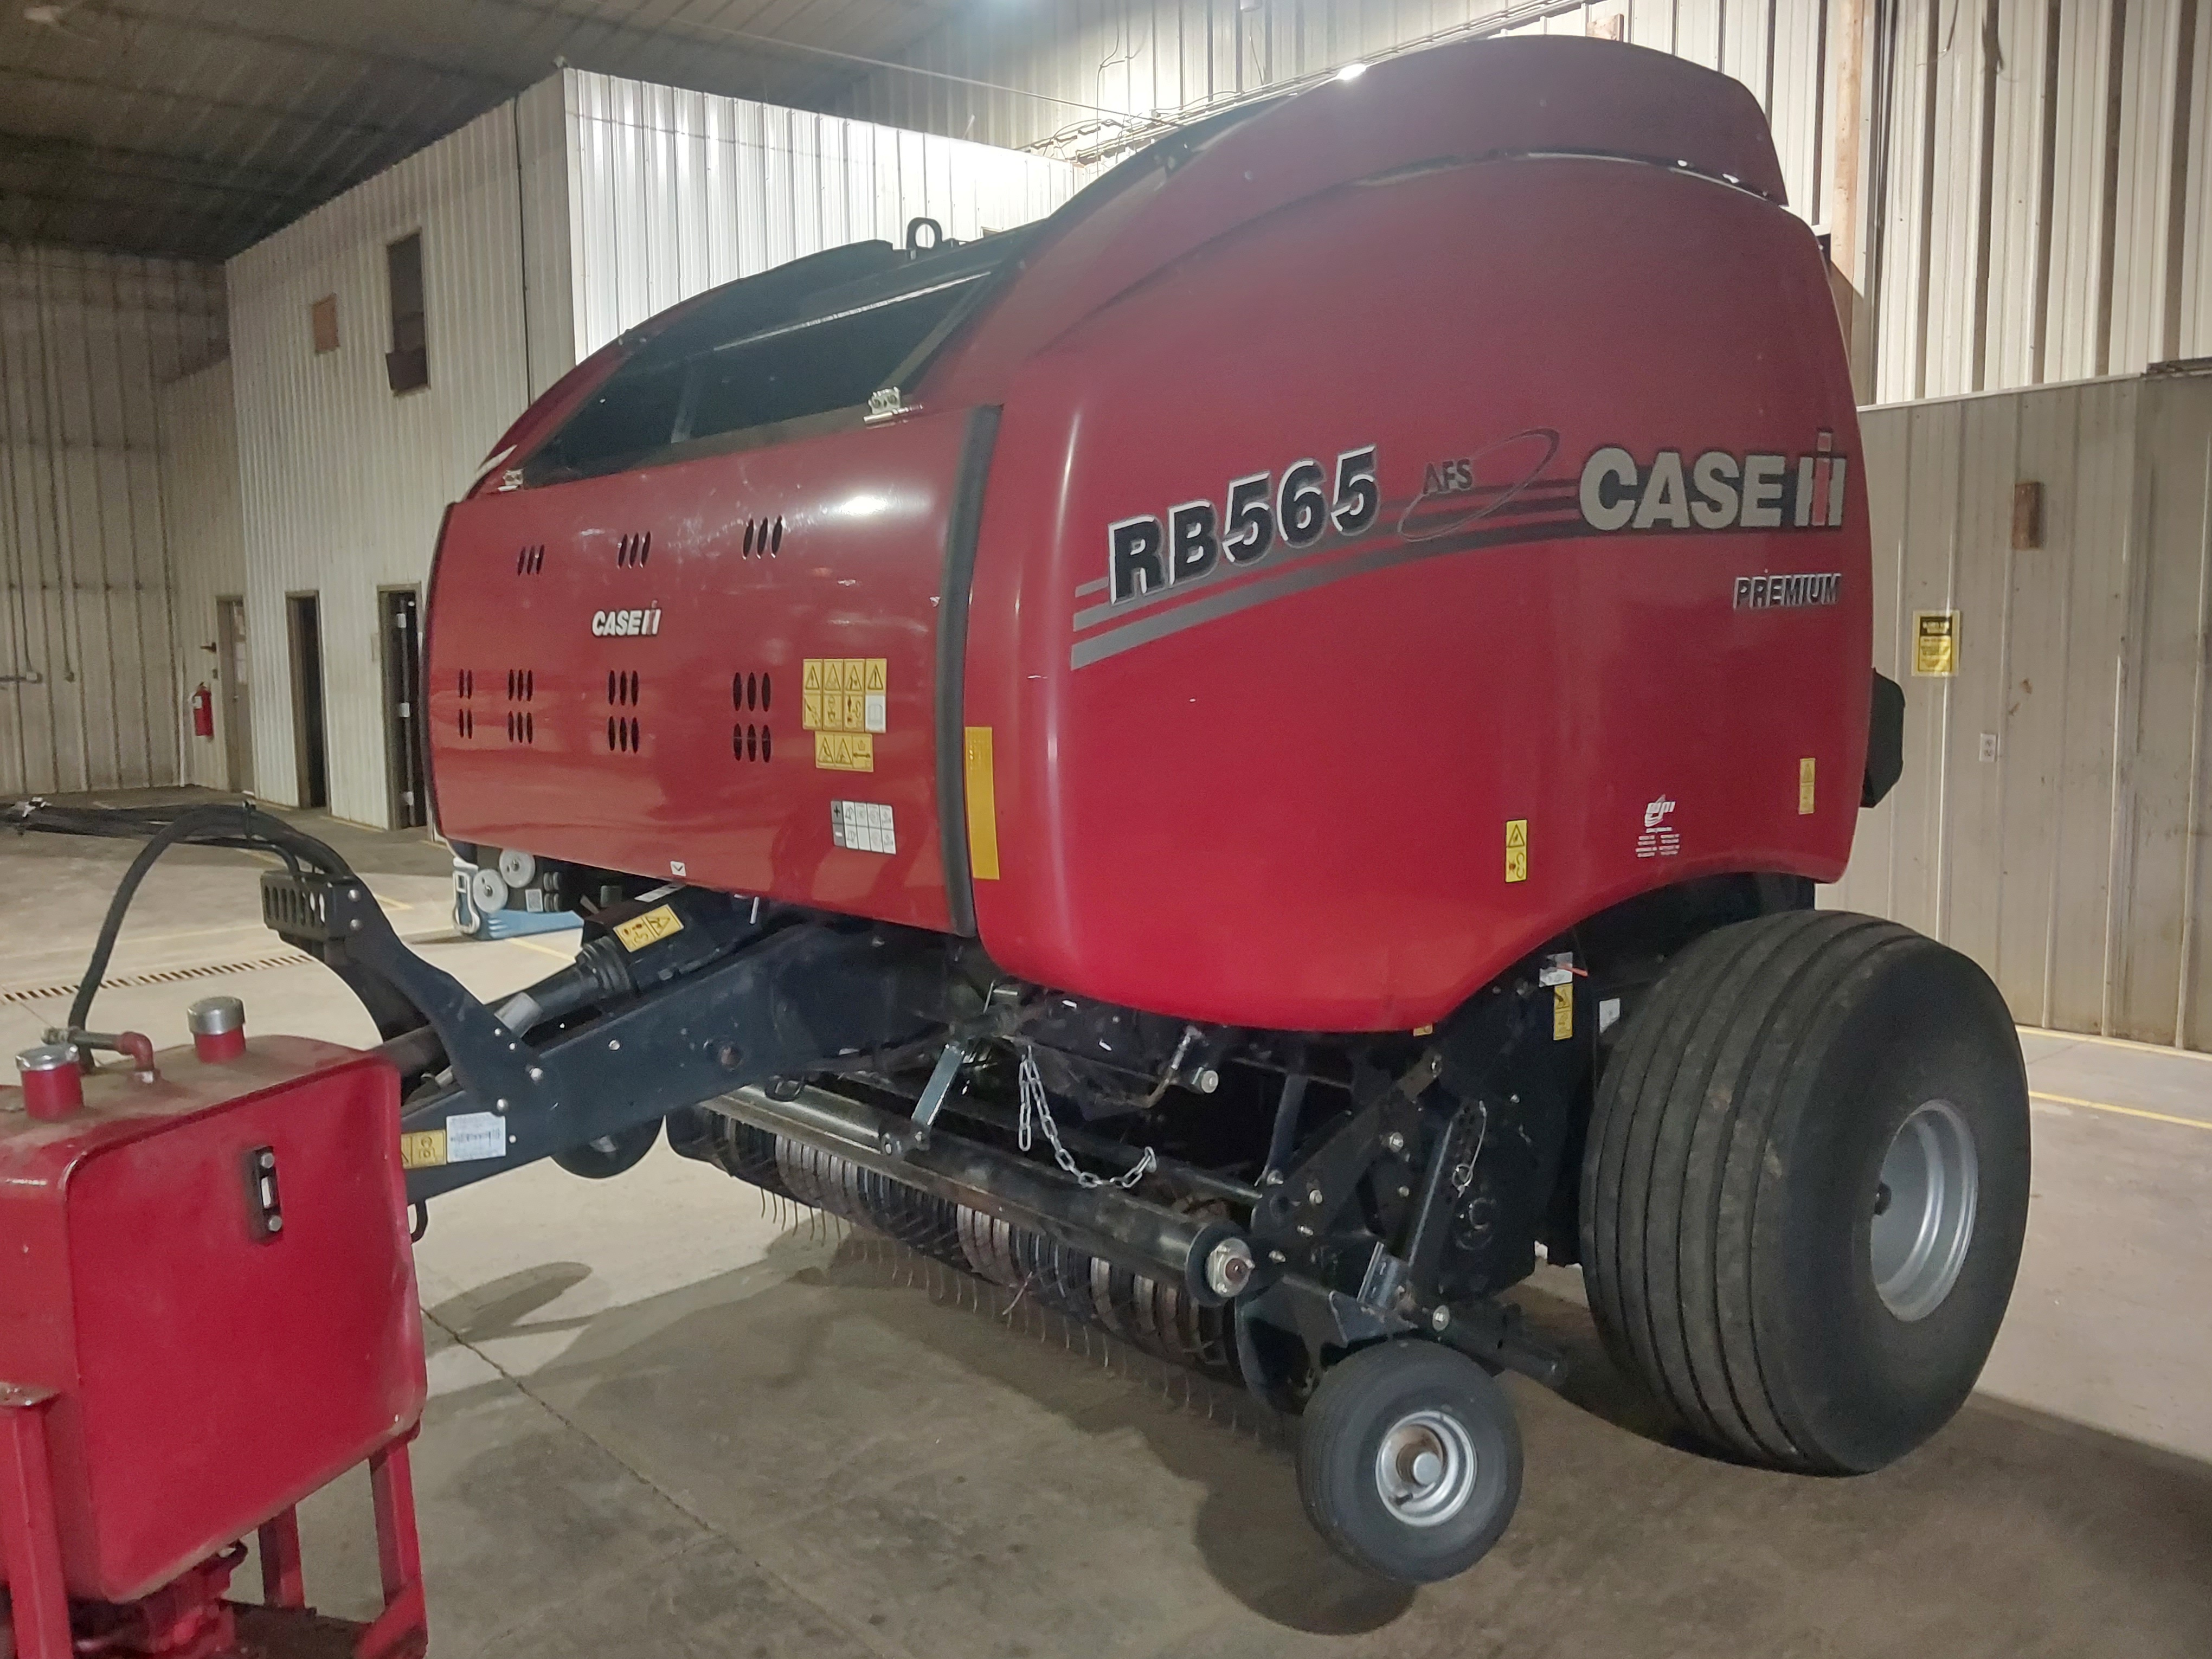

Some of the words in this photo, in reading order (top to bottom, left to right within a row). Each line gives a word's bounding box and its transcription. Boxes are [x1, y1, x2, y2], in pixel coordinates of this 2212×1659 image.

[1422, 457, 1474, 494] AFS
[1108, 443, 1380, 606] RB565
[1733, 573, 1841, 609] PREMIUM
